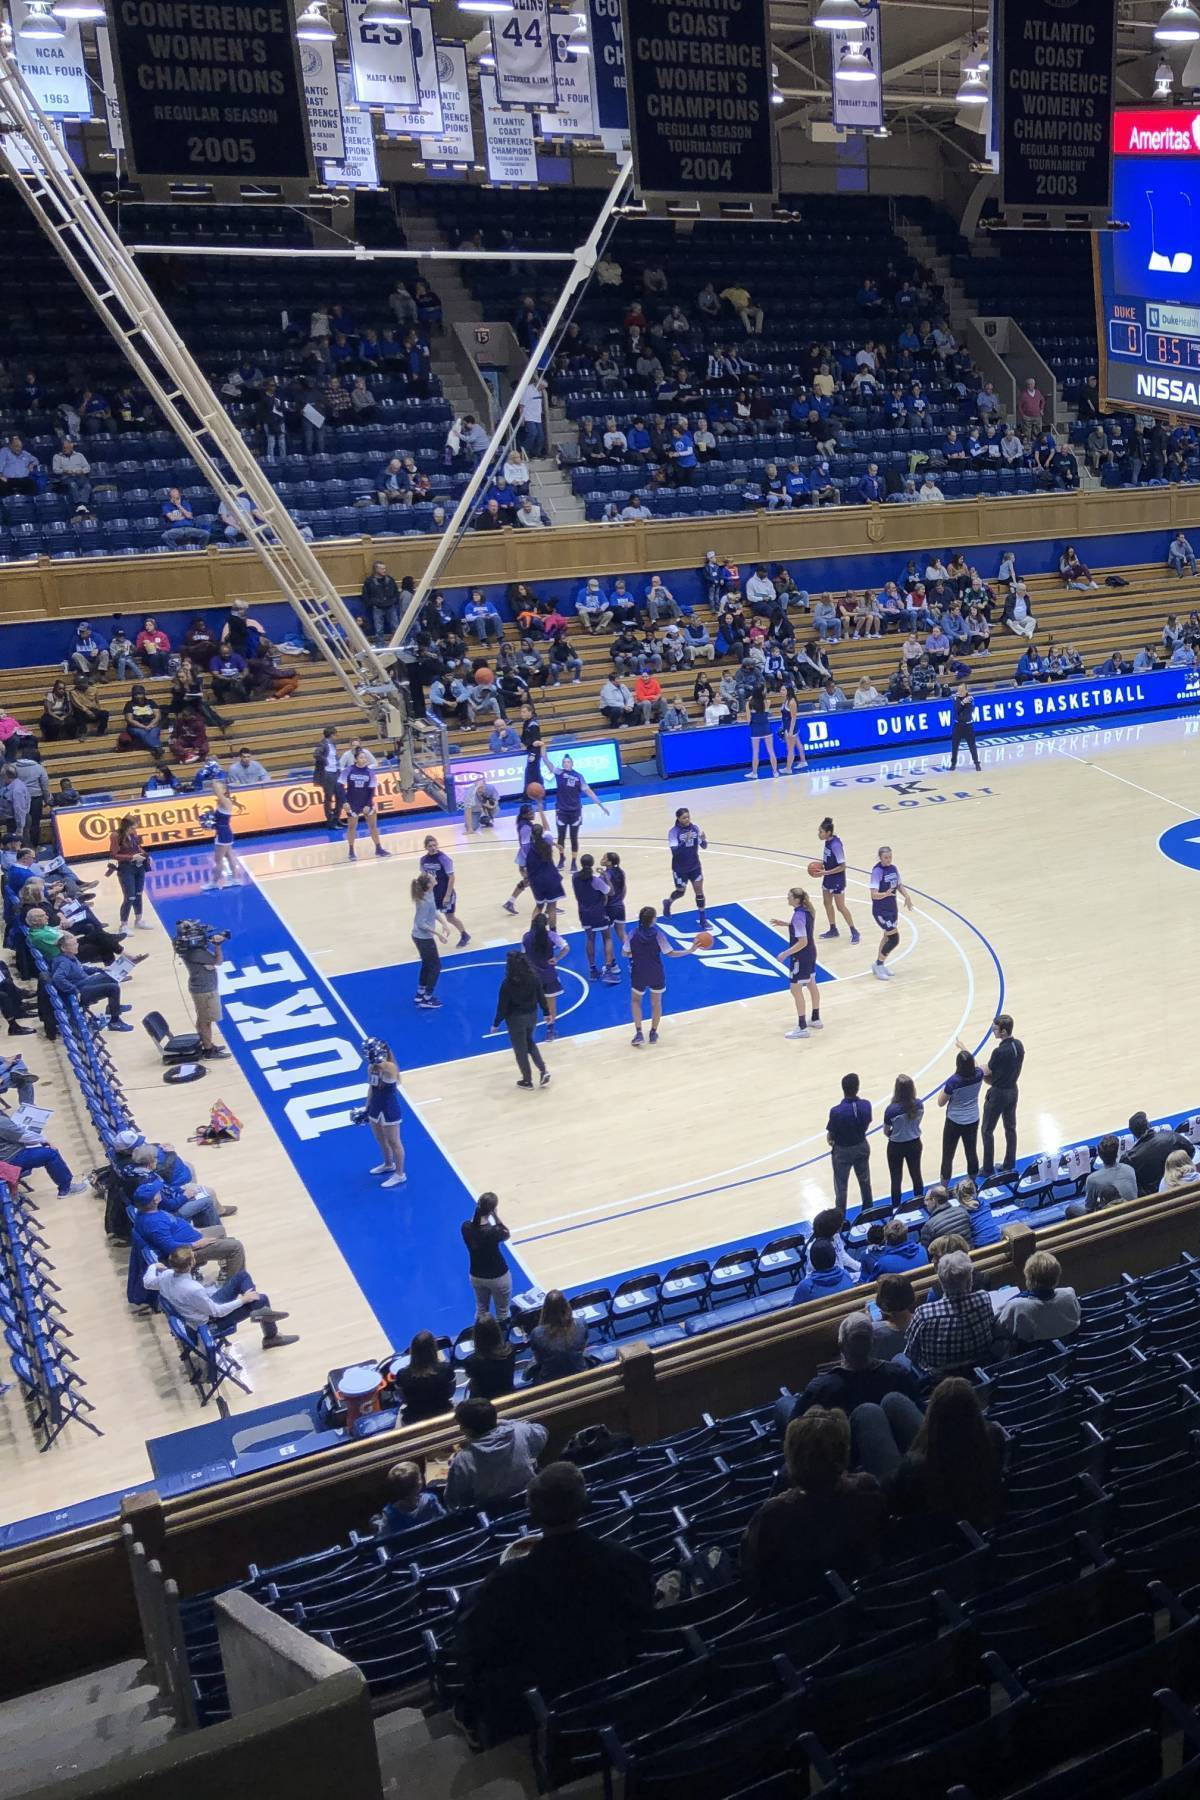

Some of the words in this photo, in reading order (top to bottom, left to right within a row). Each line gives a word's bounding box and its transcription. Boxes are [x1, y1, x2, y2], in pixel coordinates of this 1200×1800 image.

[121, 1, 284, 33] CONFERENCE
[667, 12, 730, 38] COAST
[359, 14, 403, 46] 25
[502, 17, 543, 48] 44
[1023, 20, 1095, 45] ATLANTIC
[35, 47, 65, 59] NCAA
[147, 34, 267, 64] WOMEN'S
[637, 38, 762, 68] CONFERENCE
[1034, 45, 1084, 68] COAST
[21, 64, 53, 76] FINAL
[54, 65, 83, 77] FOUR
[137, 64, 285, 96] CHAMPIONS
[655, 66, 748, 94] WOMEN'S
[304, 86, 329, 96] ANTIC
[1009, 68, 1108, 95] CONFERENCE
[305, 97, 324, 107] OAST
[419, 89, 437, 100] OUR
[567, 94, 590, 104] FOUR
[153, 105, 220, 123] REGULAR
[223, 108, 279, 124] SEASON
[308, 108, 339, 118] ERENCE
[646, 94, 760, 122] CHAMPIONS
[1023, 94, 1094, 118] WOMEN'S
[402, 115, 426, 125] 1966
[492, 117, 525, 127] ATLANTIC
[557, 118, 579, 128] 1978
[344, 126, 358, 135] AST
[498, 127, 521, 136] COAST
[656, 121, 708, 137] REGULAR
[709, 123, 752, 139] SEASON
[1014, 118, 1103, 143] CHAMPIONS
[1129, 126, 1190, 150] Ameritas
[186, 137, 256, 163] 2005
[344, 136, 373, 145] ERENCE
[488, 136, 533, 146] CONFERENCE
[667, 139, 743, 155] TOURNAMENT
[345, 146, 371, 155] PIONS
[491, 146, 532, 156] CHAMPIONS
[1020, 143, 1060, 157] REGULAR
[1061, 145, 1095, 158] SEASON
[504, 167, 524, 176] 2001
[680, 158, 734, 181] 2004
[1036, 175, 1078, 197] 2003
[1114, 305, 1137, 320] DUKE
[1161, 313, 1199, 328] DukeHealth
[475, 331, 489, 343] 15
[1127, 326, 1137, 352] 0
[1158, 336, 1191, 365] 8:51
[877, 712, 929, 736] DUKE
[938, 699, 1025, 728] WMEN'S
[1034, 684, 1145, 714] BASKETBALL
[884, 780, 937, 796] K
[872, 787, 995, 812] COURT
[78, 801, 216, 842] Coninenta
[216, 950, 370, 1142] DUKE
